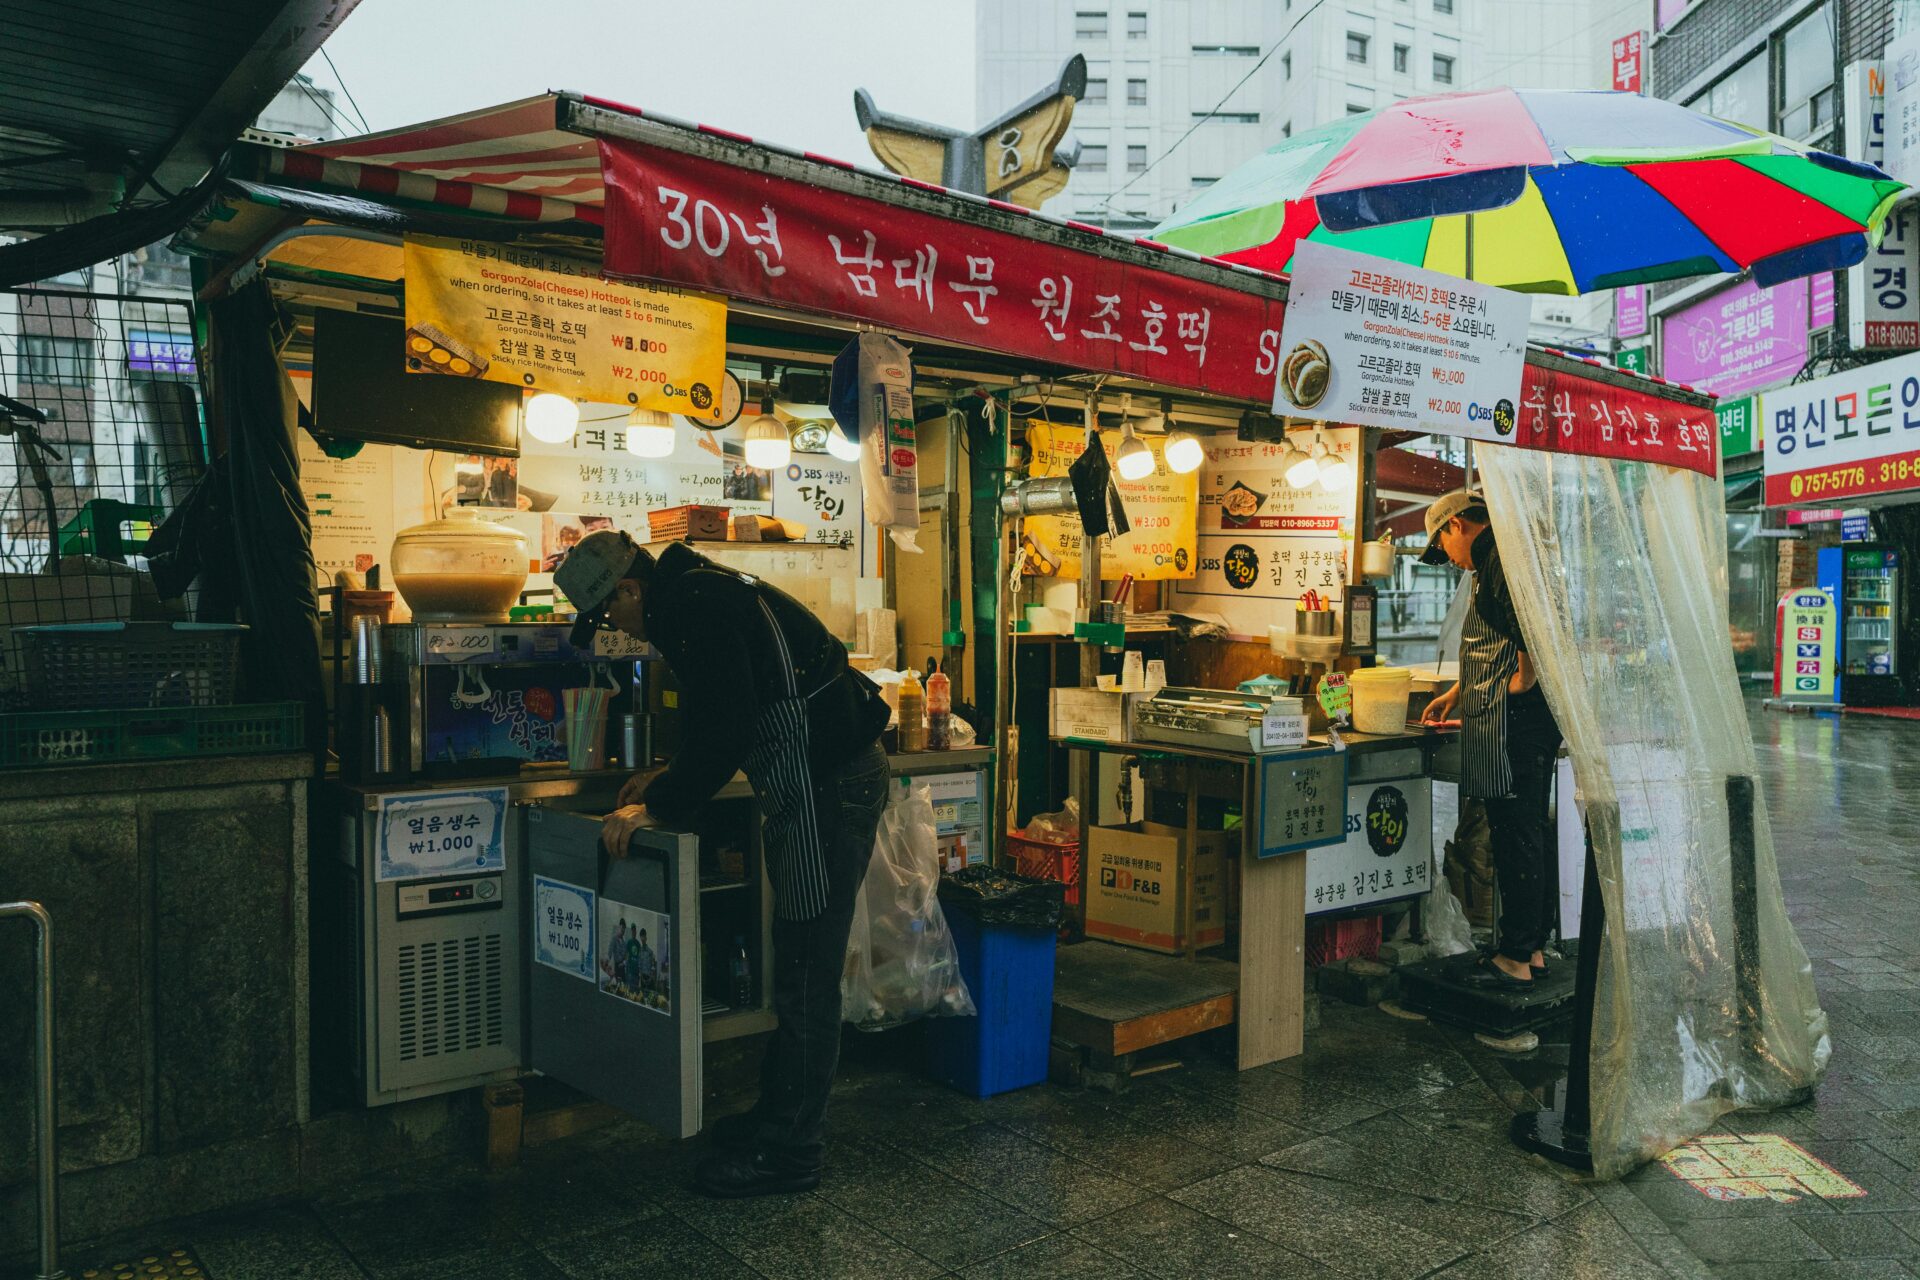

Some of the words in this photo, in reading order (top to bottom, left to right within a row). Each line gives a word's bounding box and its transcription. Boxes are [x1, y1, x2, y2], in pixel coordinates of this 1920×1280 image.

[461, 241, 500, 262] 만들기
[506, 251, 544, 272] 때문에
[550, 260, 575, 276] 최소
[657, 186, 786, 277] 30년
[828, 229, 998, 324] 남대문
[1032, 275, 1210, 368] 원조호떡
[481, 268, 589, 300] GorgonZola(Cheese)
[591, 290, 632, 306] Hotteok
[633, 298, 641, 307] is
[643, 301, 670, 314] made
[1349, 270, 1428, 304] 고르곤졸라(치즈)
[1430, 287, 1457, 311] 호떡은
[1459, 294, 1476, 315] 주문
[1478, 300, 1487, 318] 시
[450, 278, 480, 291] when
[483, 283, 531, 301] ordering,
[533, 293, 545, 303] so
[547, 295, 556, 305] it
[557, 297, 584, 311] takes
[587, 304, 597, 313] at
[600, 304, 623, 317] least
[625, 310, 631, 319] 5
[633, 311, 644, 321] to
[646, 314, 653, 323] 6
[655, 316, 695, 331] minutes.
[1332, 290, 1366, 314] 만들기
[1368, 297, 1399, 320] 때문에
[1453, 316, 1496, 341] 소요됩니다.
[484, 307, 555, 333] 고르곤졸라
[560, 321, 587, 339] 호떡
[497, 323, 544, 338] Gorgonzola
[546, 332, 577, 345] Hotteok
[1345, 331, 1362, 342] when
[1364, 336, 1391, 349] ordering,
[1393, 341, 1400, 349] so
[1401, 341, 1406, 349] it
[1407, 343, 1422, 353] takes
[1423, 346, 1429, 354] at
[1430, 346, 1443, 356] least
[1427, 333, 1449, 345] Hotteok
[1450, 337, 1455, 346] is
[1456, 340, 1470, 349] made
[1868, 325, 1916, 345] 318-8005
[500, 338, 529, 357] 찹쌀
[533, 344, 546, 360] 꿀
[551, 348, 577, 366] 호떡
[492, 354, 515, 366] Sticky
[517, 358, 532, 367] rice
[534, 360, 555, 372] Honey
[557, 365, 586, 377] Hotteok
[611, 365, 667, 384] ₩2,000
[1358, 354, 1403, 375] 고르곤졸라
[1404, 361, 1421, 379] 호떡
[674, 387, 688, 397] SBS
[1394, 376, 1415, 387] Hotteok
[1362, 386, 1381, 404] 찹쌀
[1382, 390, 1391, 406] 꿀
[1392, 392, 1410, 409] 호떡
[1428, 397, 1462, 415] ₩2,000
[1349, 402, 1366, 413] Sticky
[1368, 405, 1378, 414] rice
[1379, 406, 1396, 418] Honey
[1397, 409, 1418, 419] Hotteok
[1478, 407, 1493, 420] SBS
[1718, 405, 1745, 437] 센터
[1590, 400, 1664, 446] 김진호
[1677, 417, 1712, 463] 호떡
[804, 469, 822, 479] SBS
[1805, 467, 1865, 493] 757-5776
[798, 485, 844, 520] 달인
[1125, 494, 1141, 503] least
[1059, 533, 1081, 548] 찹쌀
[1202, 558, 1220, 571] SBS
[1270, 550, 1291, 564] 호떡
[1299, 550, 1334, 566] 왕중왕
[1227, 559, 1255, 582] 달인
[1073, 727, 1107, 736] STANDARD
[408, 814, 480, 835] 얼음생수
[1347, 814, 1361, 834] BS
[1369, 809, 1403, 845] 달인
[409, 835, 473, 854] ₩1,000
[1134, 878, 1161, 895] F&B
[1315, 883, 1346, 904] 왕중왕
[1354, 869, 1394, 896] 김진호
[1402, 861, 1427, 885] 호떡
[547, 906, 582, 931] 얼음생수
[548, 930, 580, 951] ₩1,000
